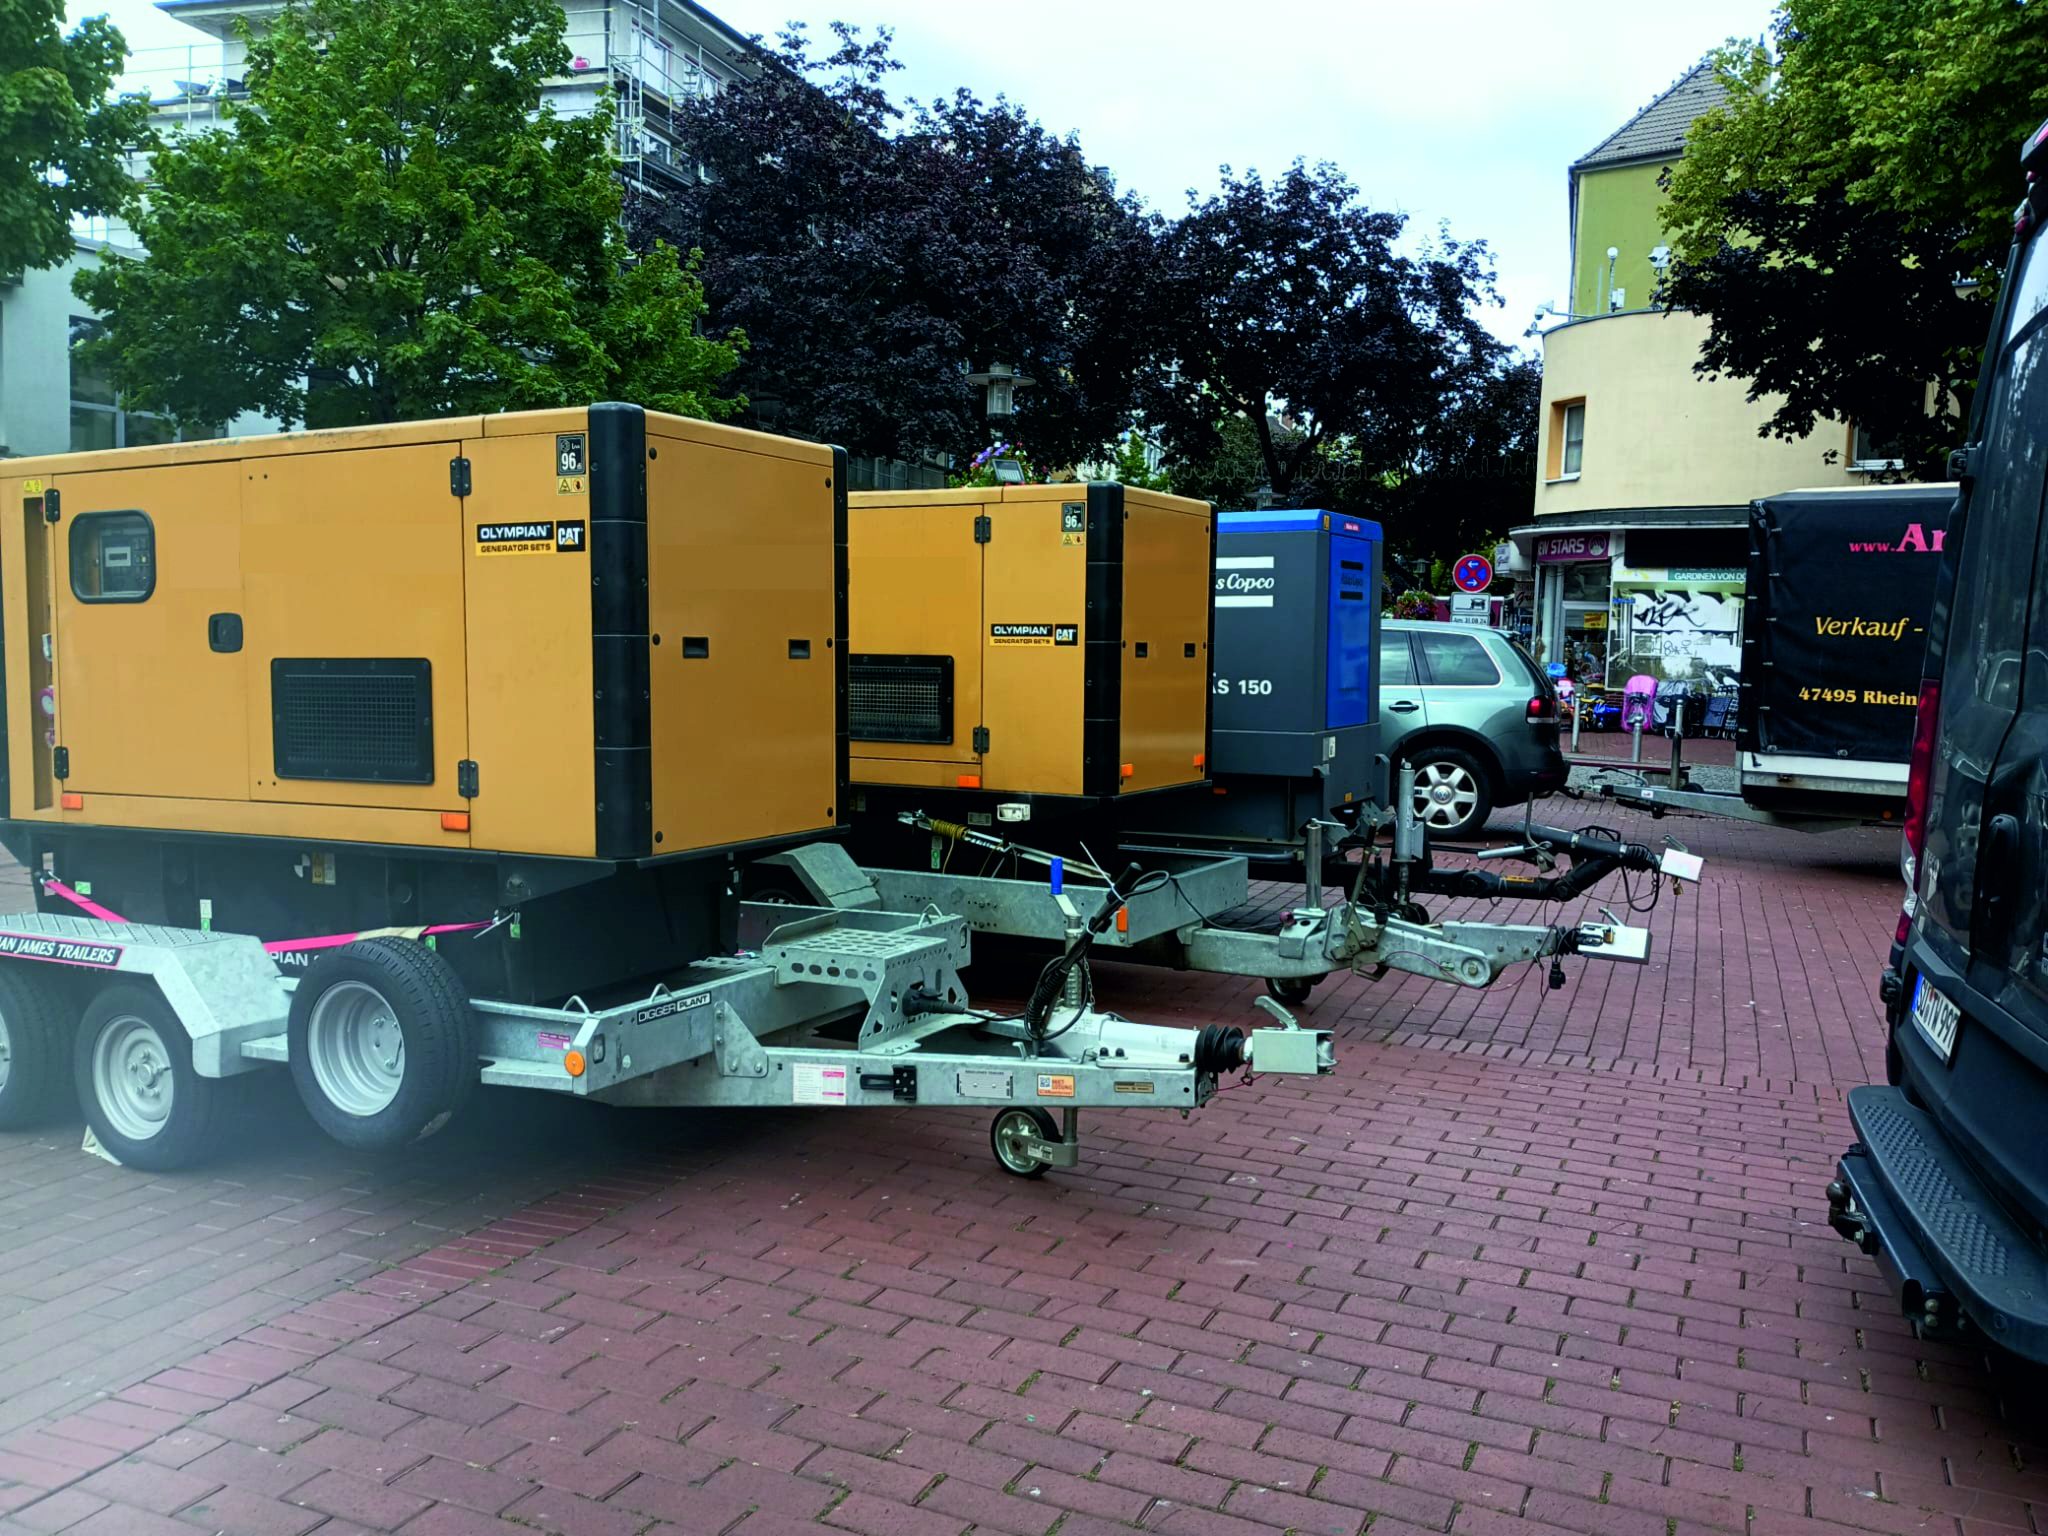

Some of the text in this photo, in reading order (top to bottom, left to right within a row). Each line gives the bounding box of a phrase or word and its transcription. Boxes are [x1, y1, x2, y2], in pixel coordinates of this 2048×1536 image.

[561, 452, 576, 470] 96
[1065, 515, 1077, 528] 96
[480, 525, 547, 539] OLYMPIAN
[558, 527, 580, 545] CAT
[481, 543, 551, 553] GENERATOR SETS
[1551, 537, 1585, 555] STARS
[1226, 573, 1275, 592] Copco
[1674, 572, 1716, 580] GARDINEN
[1717, 572, 1735, 580] VON
[994, 626, 1047, 634] OLYMPIAN
[1056, 629, 1074, 641] CAT
[1815, 617, 1909, 641] Verkauf
[1239, 680, 1272, 695] 150
[1799, 687, 1856, 702] 47495
[14, 939, 55, 956] JAMES
[56, 943, 116, 964] TRAILERS
[638, 995, 708, 1021] DIGGER PLANT
